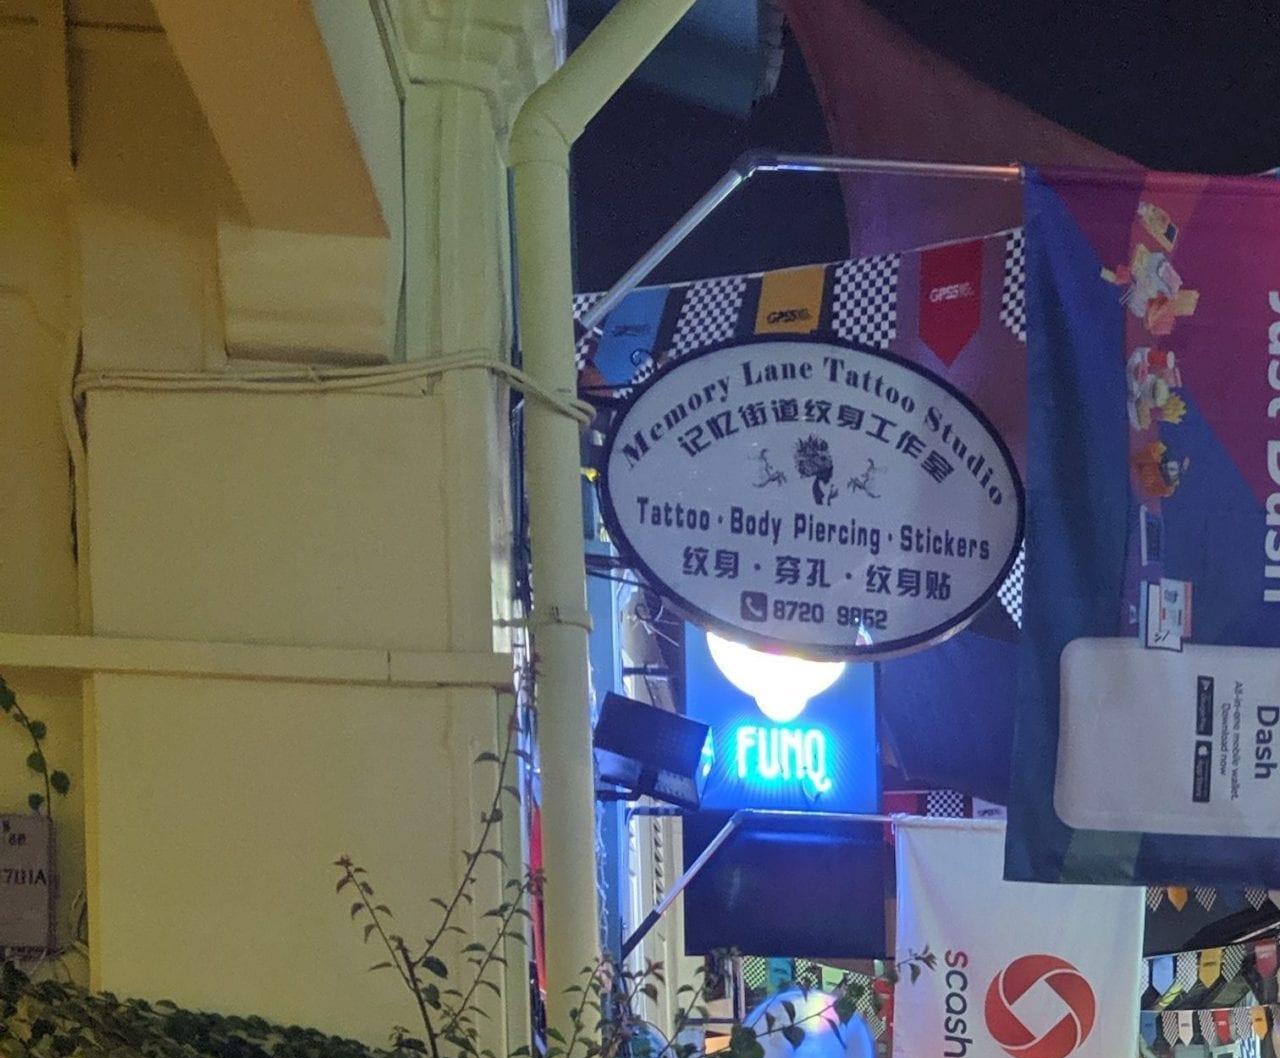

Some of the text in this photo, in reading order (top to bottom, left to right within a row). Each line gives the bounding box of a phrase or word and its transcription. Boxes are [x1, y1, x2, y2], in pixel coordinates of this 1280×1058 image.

[620, 356, 1004, 507] Memory Lane Tattoo Studio
[678, 397, 956, 487] 记忆街道纹身工作室
[637, 497, 990, 561] Tattoo Body Piercing Stickers
[773, 599, 825, 624] 8720
[1254, 705, 1280, 779] Dash
[944, 949, 974, 1058] scash
